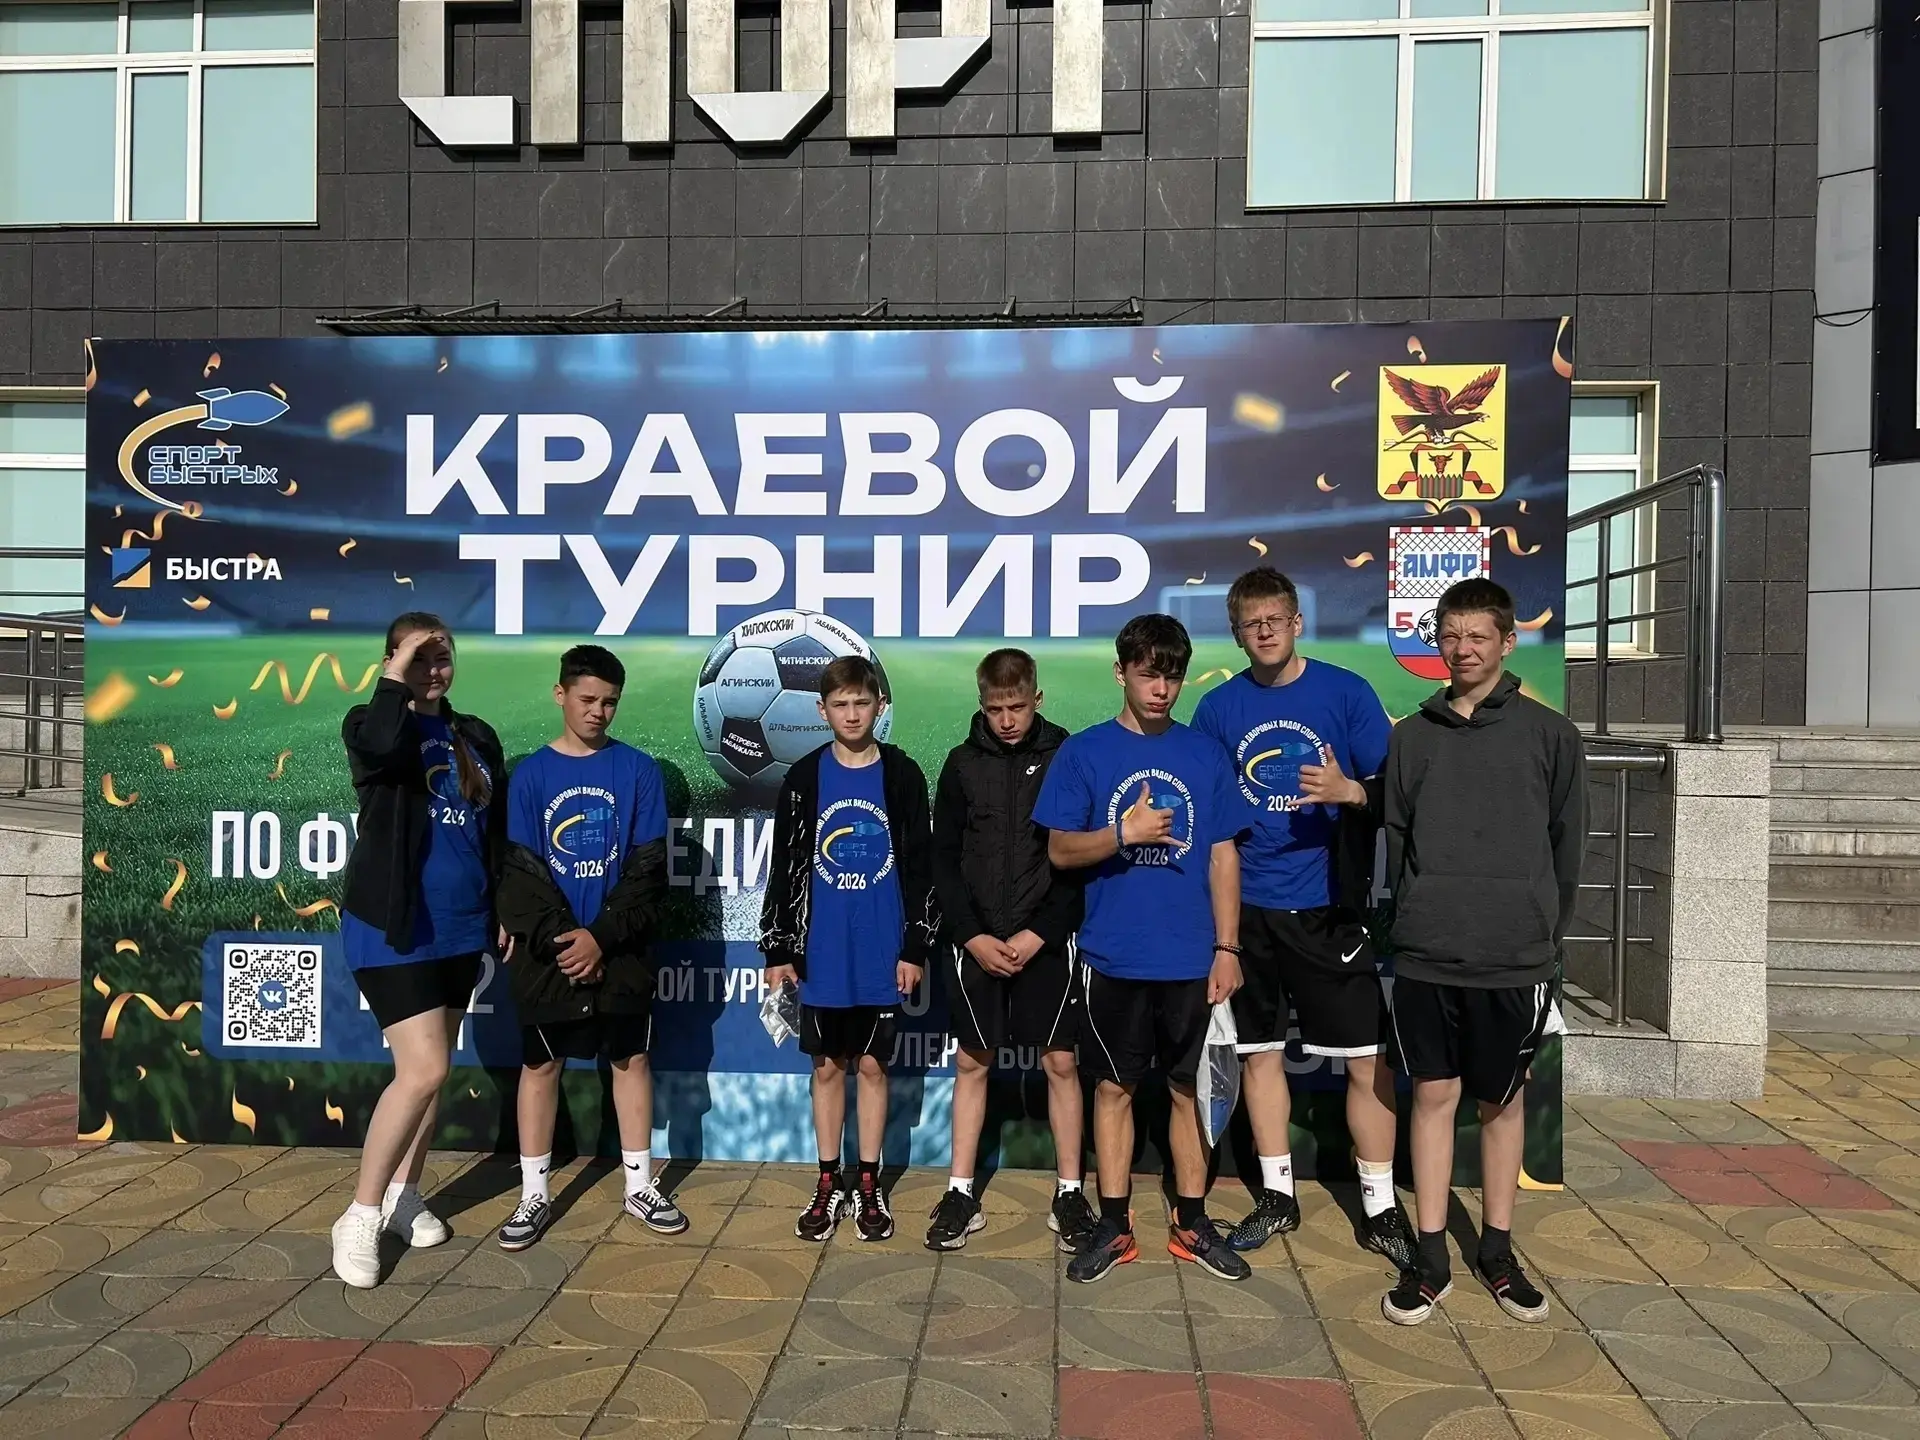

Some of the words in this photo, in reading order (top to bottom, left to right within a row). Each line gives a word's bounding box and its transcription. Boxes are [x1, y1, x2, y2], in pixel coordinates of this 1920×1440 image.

[149, 446, 241, 464] СПОРТ
[405, 377, 1208, 517] КРАЕВОЙ
[149, 465, 278, 484] БЫСТРЫХ
[166, 558, 282, 580] БЫСТРА
[1403, 552, 1478, 579] АМФР
[458, 534, 1152, 638] ТУРНИР
[741, 618, 795, 637] ХИЛОКСКИЙ
[1395, 612, 1414, 638] 5
[721, 678, 774, 688] АГИНСКИЙ
[1244, 719, 1279, 744] ДВОРОВЫХ
[1278, 719, 1302, 731] ВИДОВ
[1299, 725, 1323, 748] СПОРТА
[1107, 792, 1122, 827] АЗВИТИЮ
[1117, 769, 1151, 795] ДВОРОВЫХ
[1151, 768, 1174, 782] ВИДОВ
[1171, 777, 1192, 802] СПОРТА
[821, 798, 853, 822] ДВОРОВЫХ
[853, 798, 876, 812] ВИДОВ
[212, 810, 281, 879] ПО
[666, 818, 775, 896] ЕДИ
[1135, 847, 1169, 866] 2026
[573, 860, 604, 879] 2026
[837, 873, 867, 890] 2026
[703, 966, 770, 1004] ТУРН
